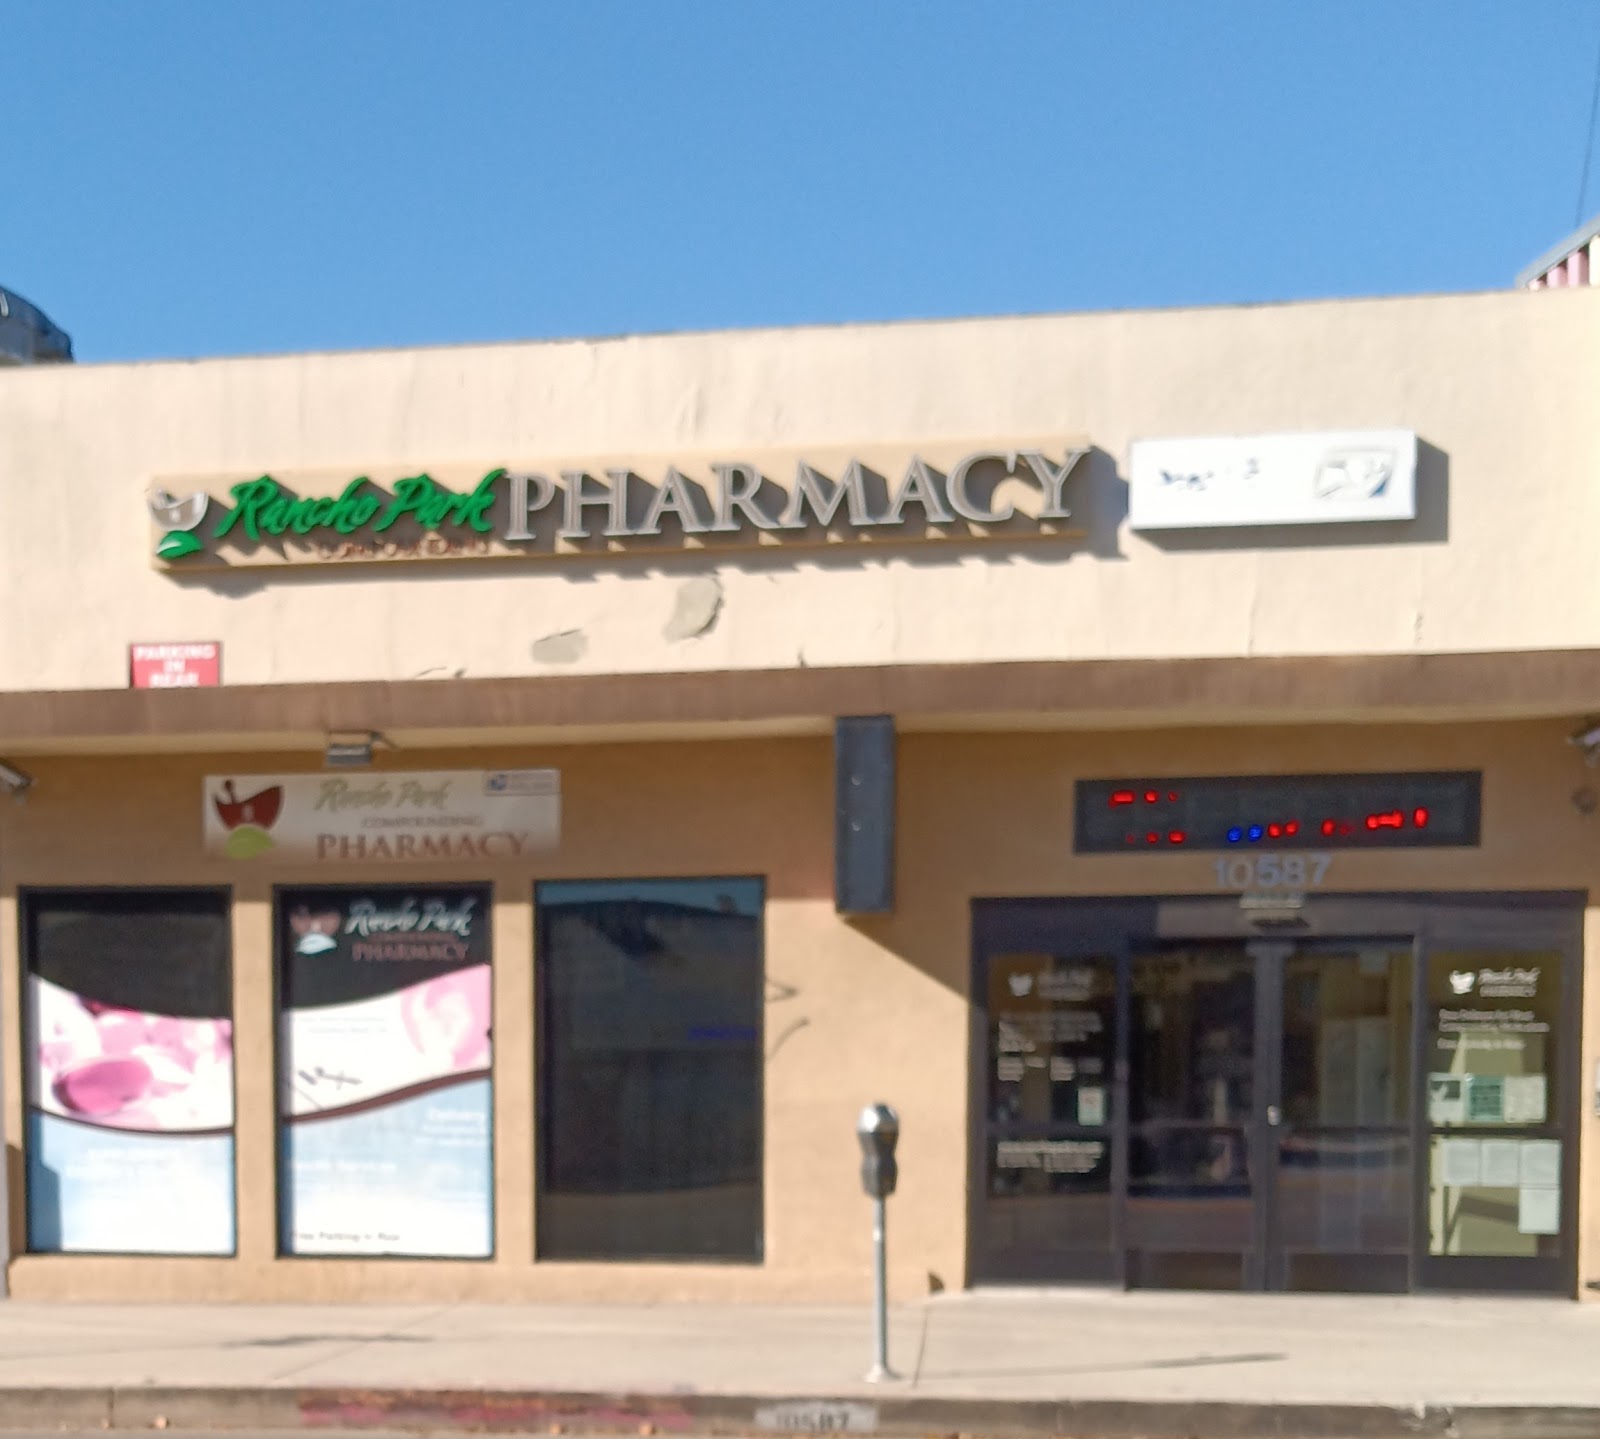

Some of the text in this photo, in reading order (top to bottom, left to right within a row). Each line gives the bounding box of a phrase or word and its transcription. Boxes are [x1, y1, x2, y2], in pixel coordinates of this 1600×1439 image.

[213, 446, 1093, 542] Rancho Park PHARMACY
[315, 832, 529, 861] PHARMACY
[1213, 852, 1333, 888] 10587
